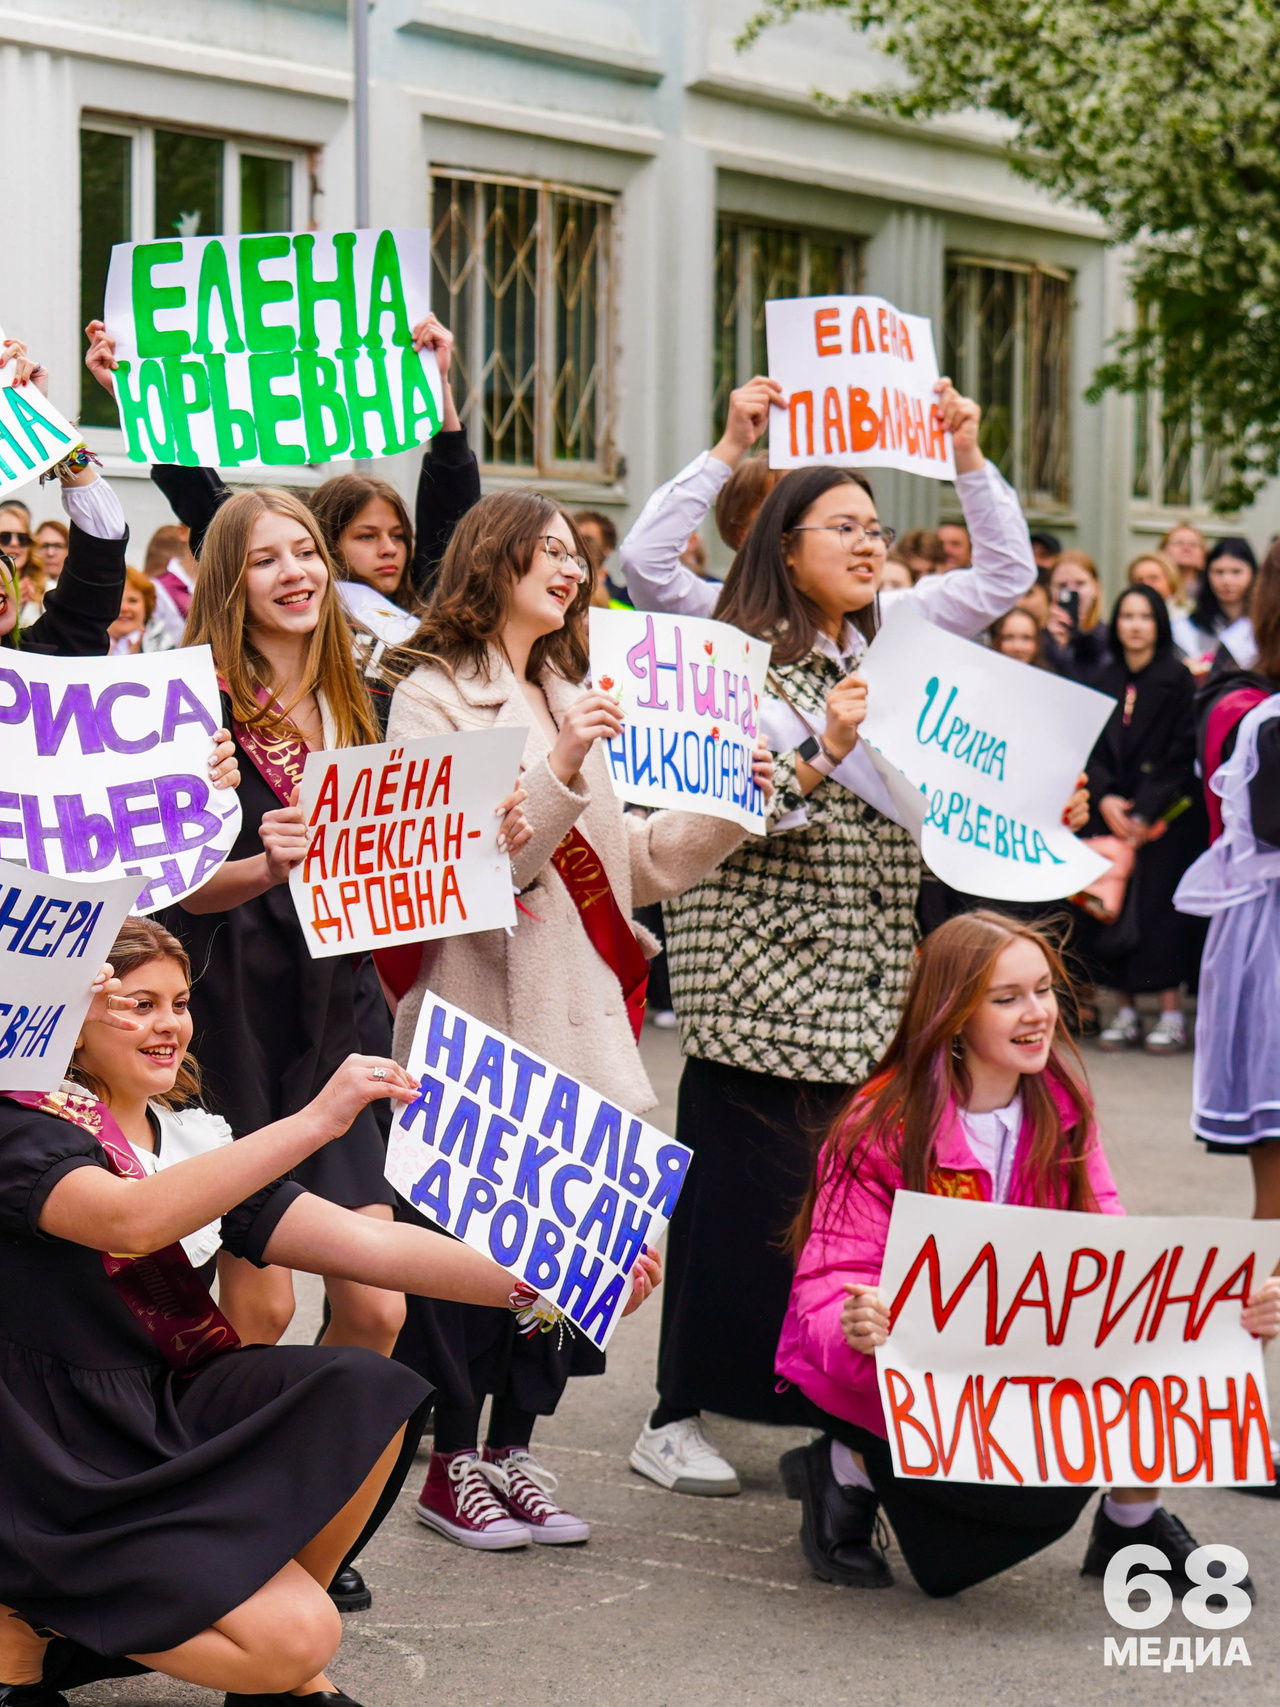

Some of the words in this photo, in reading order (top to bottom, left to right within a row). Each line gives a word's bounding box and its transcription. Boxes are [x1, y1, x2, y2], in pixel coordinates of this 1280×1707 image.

[132, 230, 415, 358] ЕЛЕНА
[815, 306, 914, 361] ЕЛЕНА
[111, 347, 443, 467] ЮРЬЕВНА
[309, 748, 453, 826] АЛЁНА
[303, 812, 481, 883] АЛЕКСАН-
[311, 865, 467, 944] ДРОВНА
[425, 1005, 691, 1220] НАТАЛЬЯ
[410, 1158, 625, 1346] ДРОВНА
[888, 1234, 1260, 1348] МАРИНА
[885, 1368, 1276, 1485] ВИКТОРОВНА
